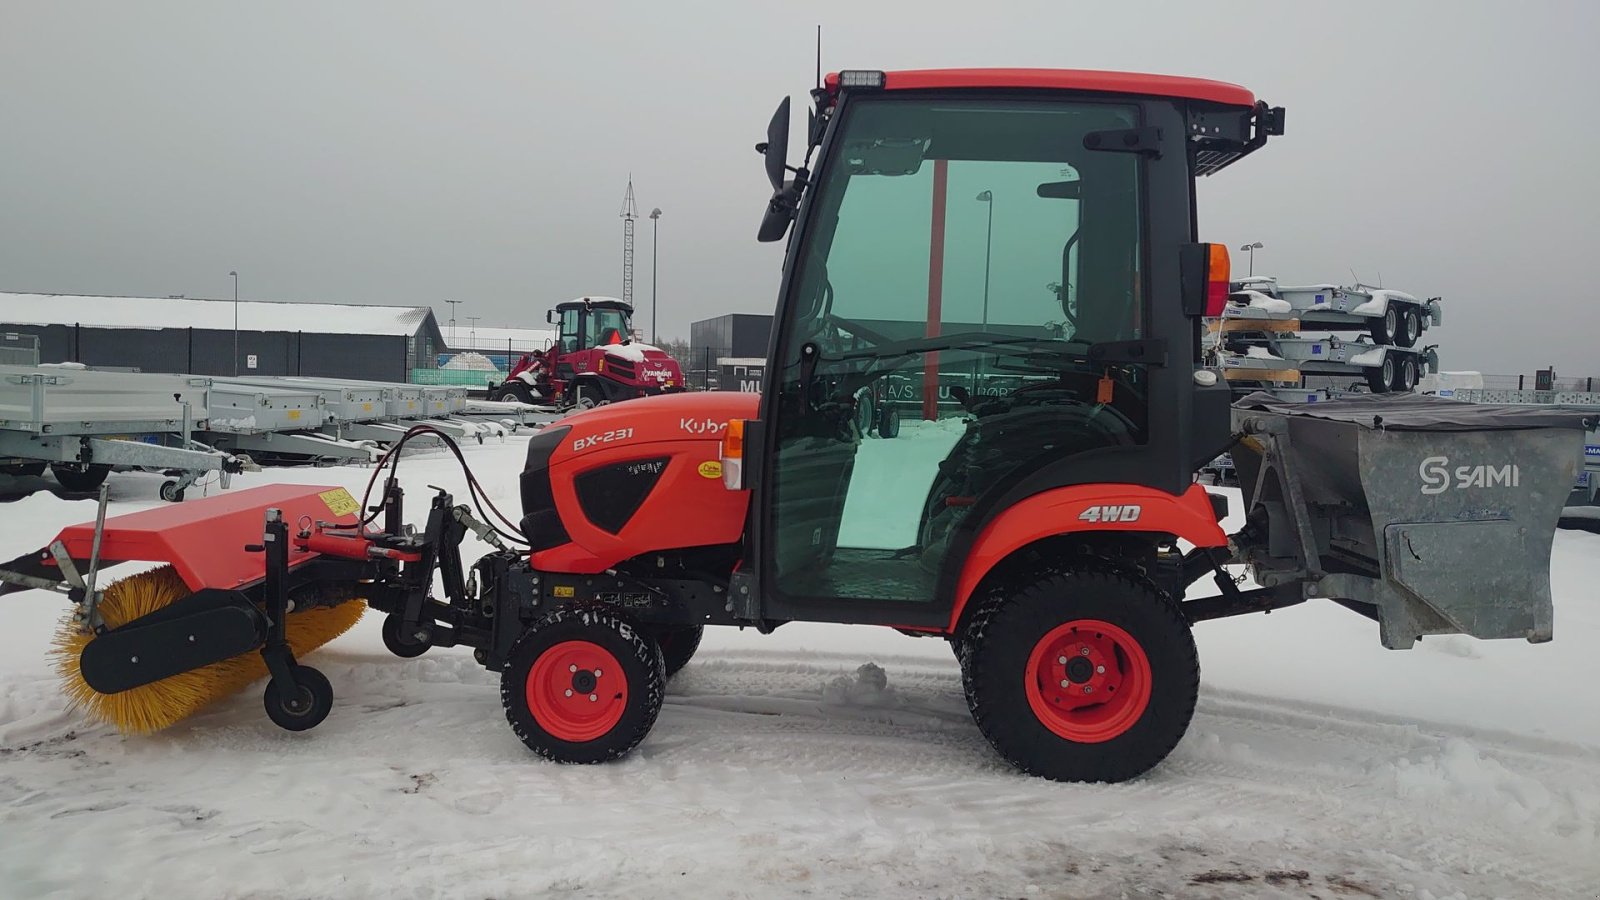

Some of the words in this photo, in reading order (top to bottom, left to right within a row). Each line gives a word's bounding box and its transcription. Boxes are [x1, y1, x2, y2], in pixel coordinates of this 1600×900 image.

[573, 428, 634, 451] BX-231
[1455, 464, 1519, 488] SAMI
[1078, 505, 1141, 522] 4WD
